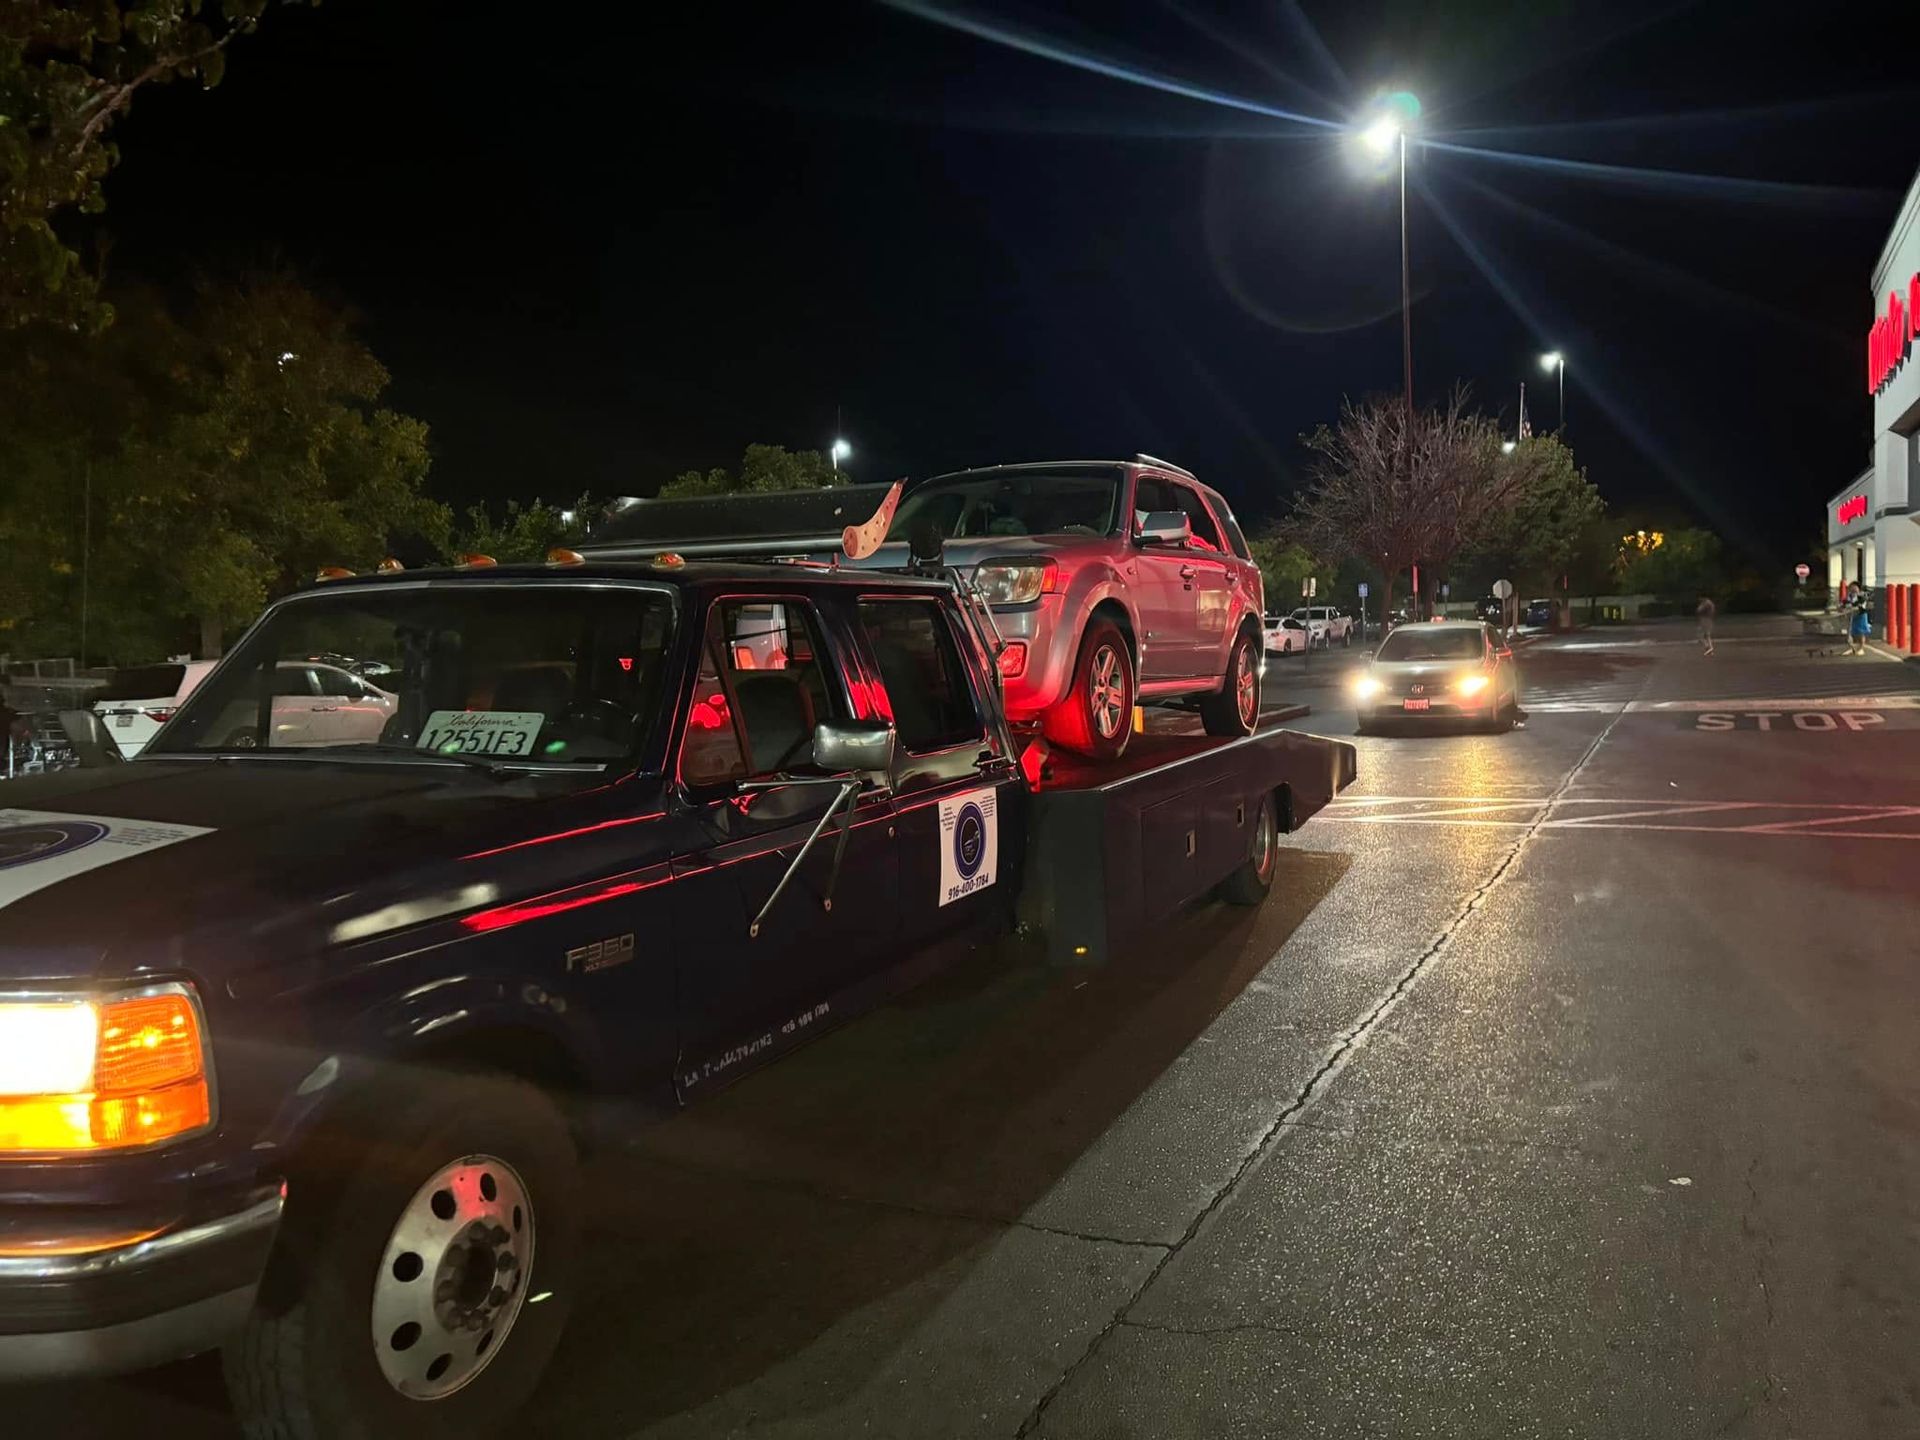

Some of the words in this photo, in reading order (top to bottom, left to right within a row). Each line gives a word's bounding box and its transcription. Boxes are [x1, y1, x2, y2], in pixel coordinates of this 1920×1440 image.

[449, 713, 517, 729] California
[1696, 712, 1885, 731] STOP
[425, 729, 528, 754] 12551F3
[947, 873, 990, 900] 916-400-1784
[565, 933, 635, 972] F350
